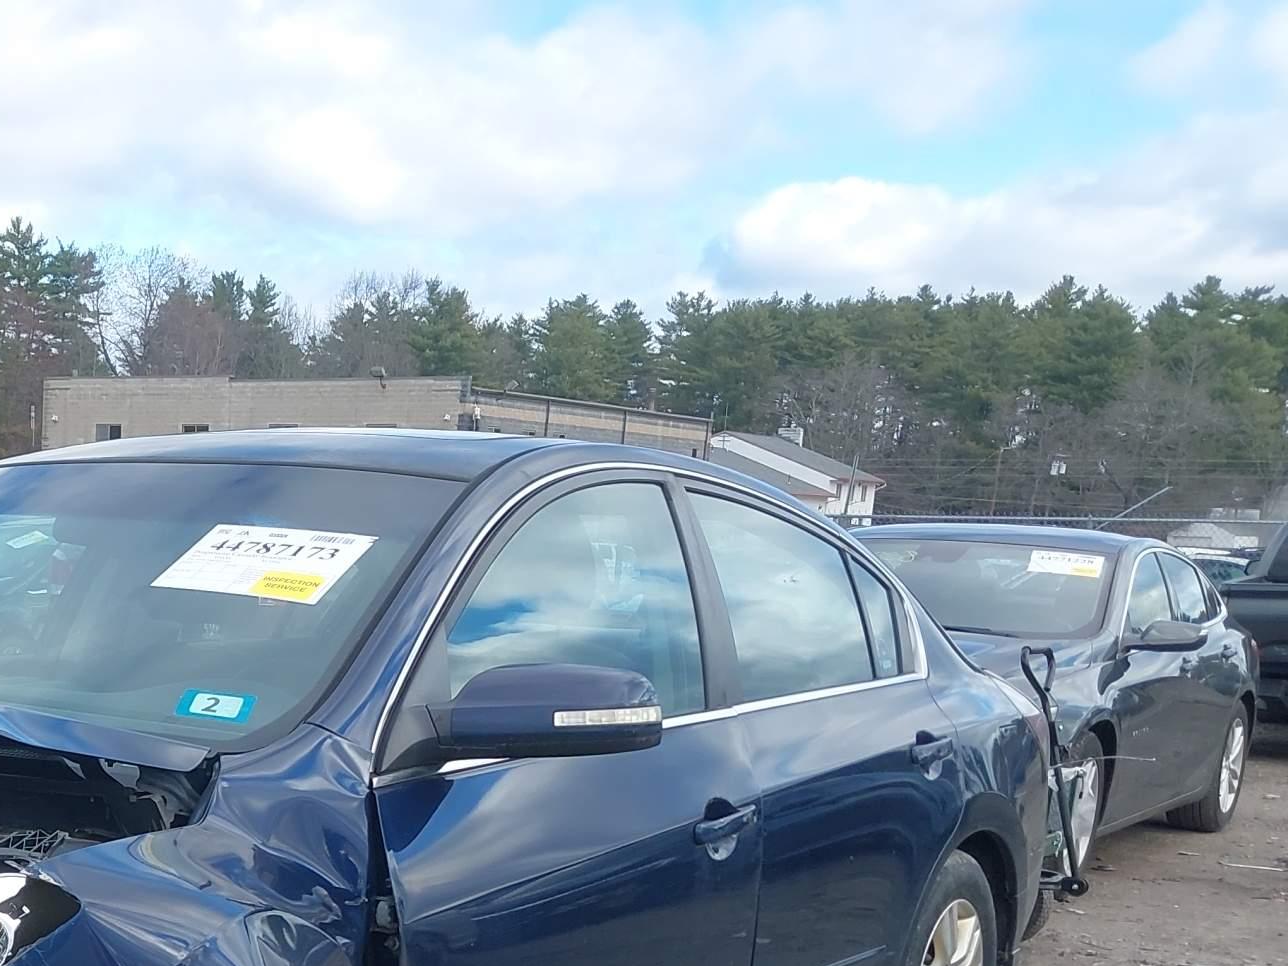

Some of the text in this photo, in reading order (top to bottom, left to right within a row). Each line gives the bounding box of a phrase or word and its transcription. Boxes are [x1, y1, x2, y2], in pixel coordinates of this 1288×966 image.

[210, 539, 340, 561] 44787173
[263, 576, 320, 588] INSPECTION
[264, 582, 307, 593] SERVICE
[200, 696, 221, 713] 2
